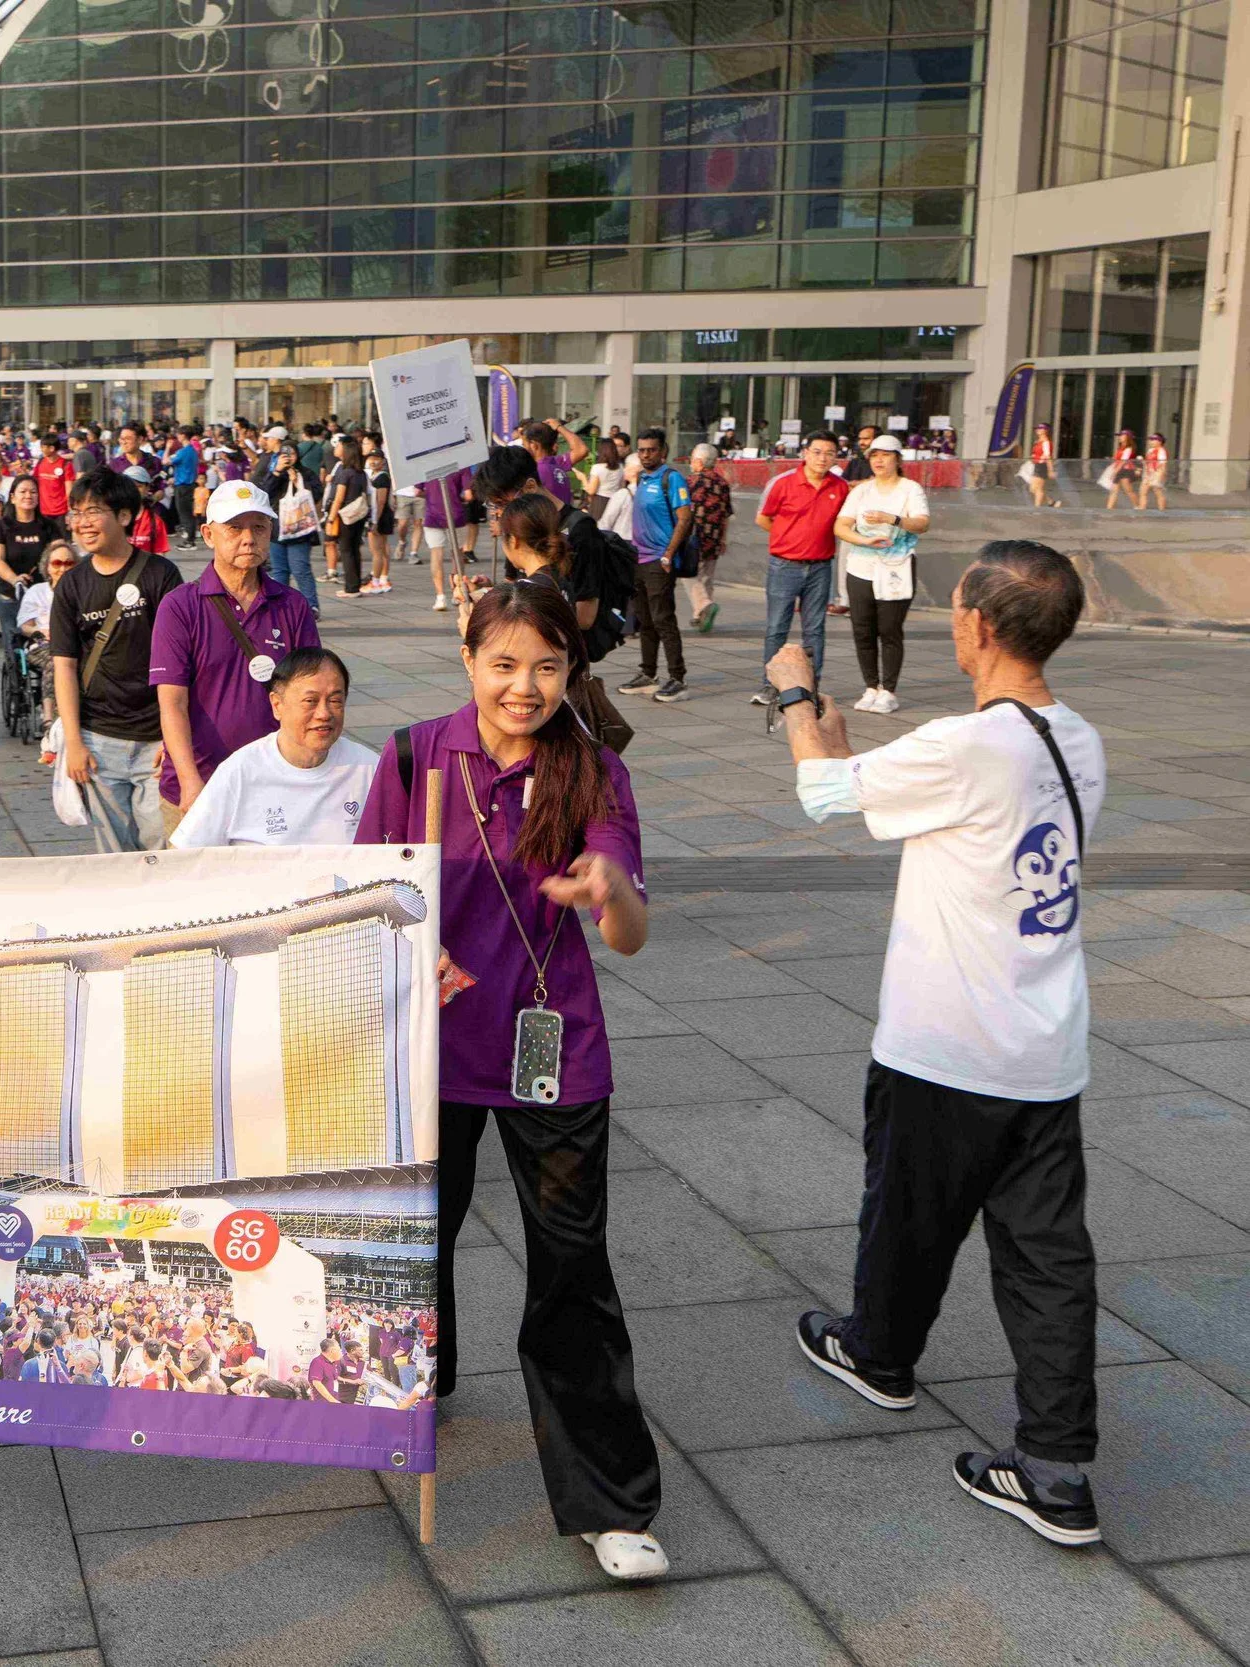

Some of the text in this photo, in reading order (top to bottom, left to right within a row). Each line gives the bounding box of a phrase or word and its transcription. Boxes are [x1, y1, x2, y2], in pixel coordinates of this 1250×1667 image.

[695, 329, 738, 345] TASAKI
[408, 388, 449, 407] BEFRIENDING
[406, 399, 458, 420] MEDICAL ESCORT
[422, 415, 448, 430] SERVICE
[45, 1204, 93, 1220] READY
[97, 1204, 124, 1220] SET
[229, 1218, 265, 1240] SG
[226, 1238, 261, 1262] 60
